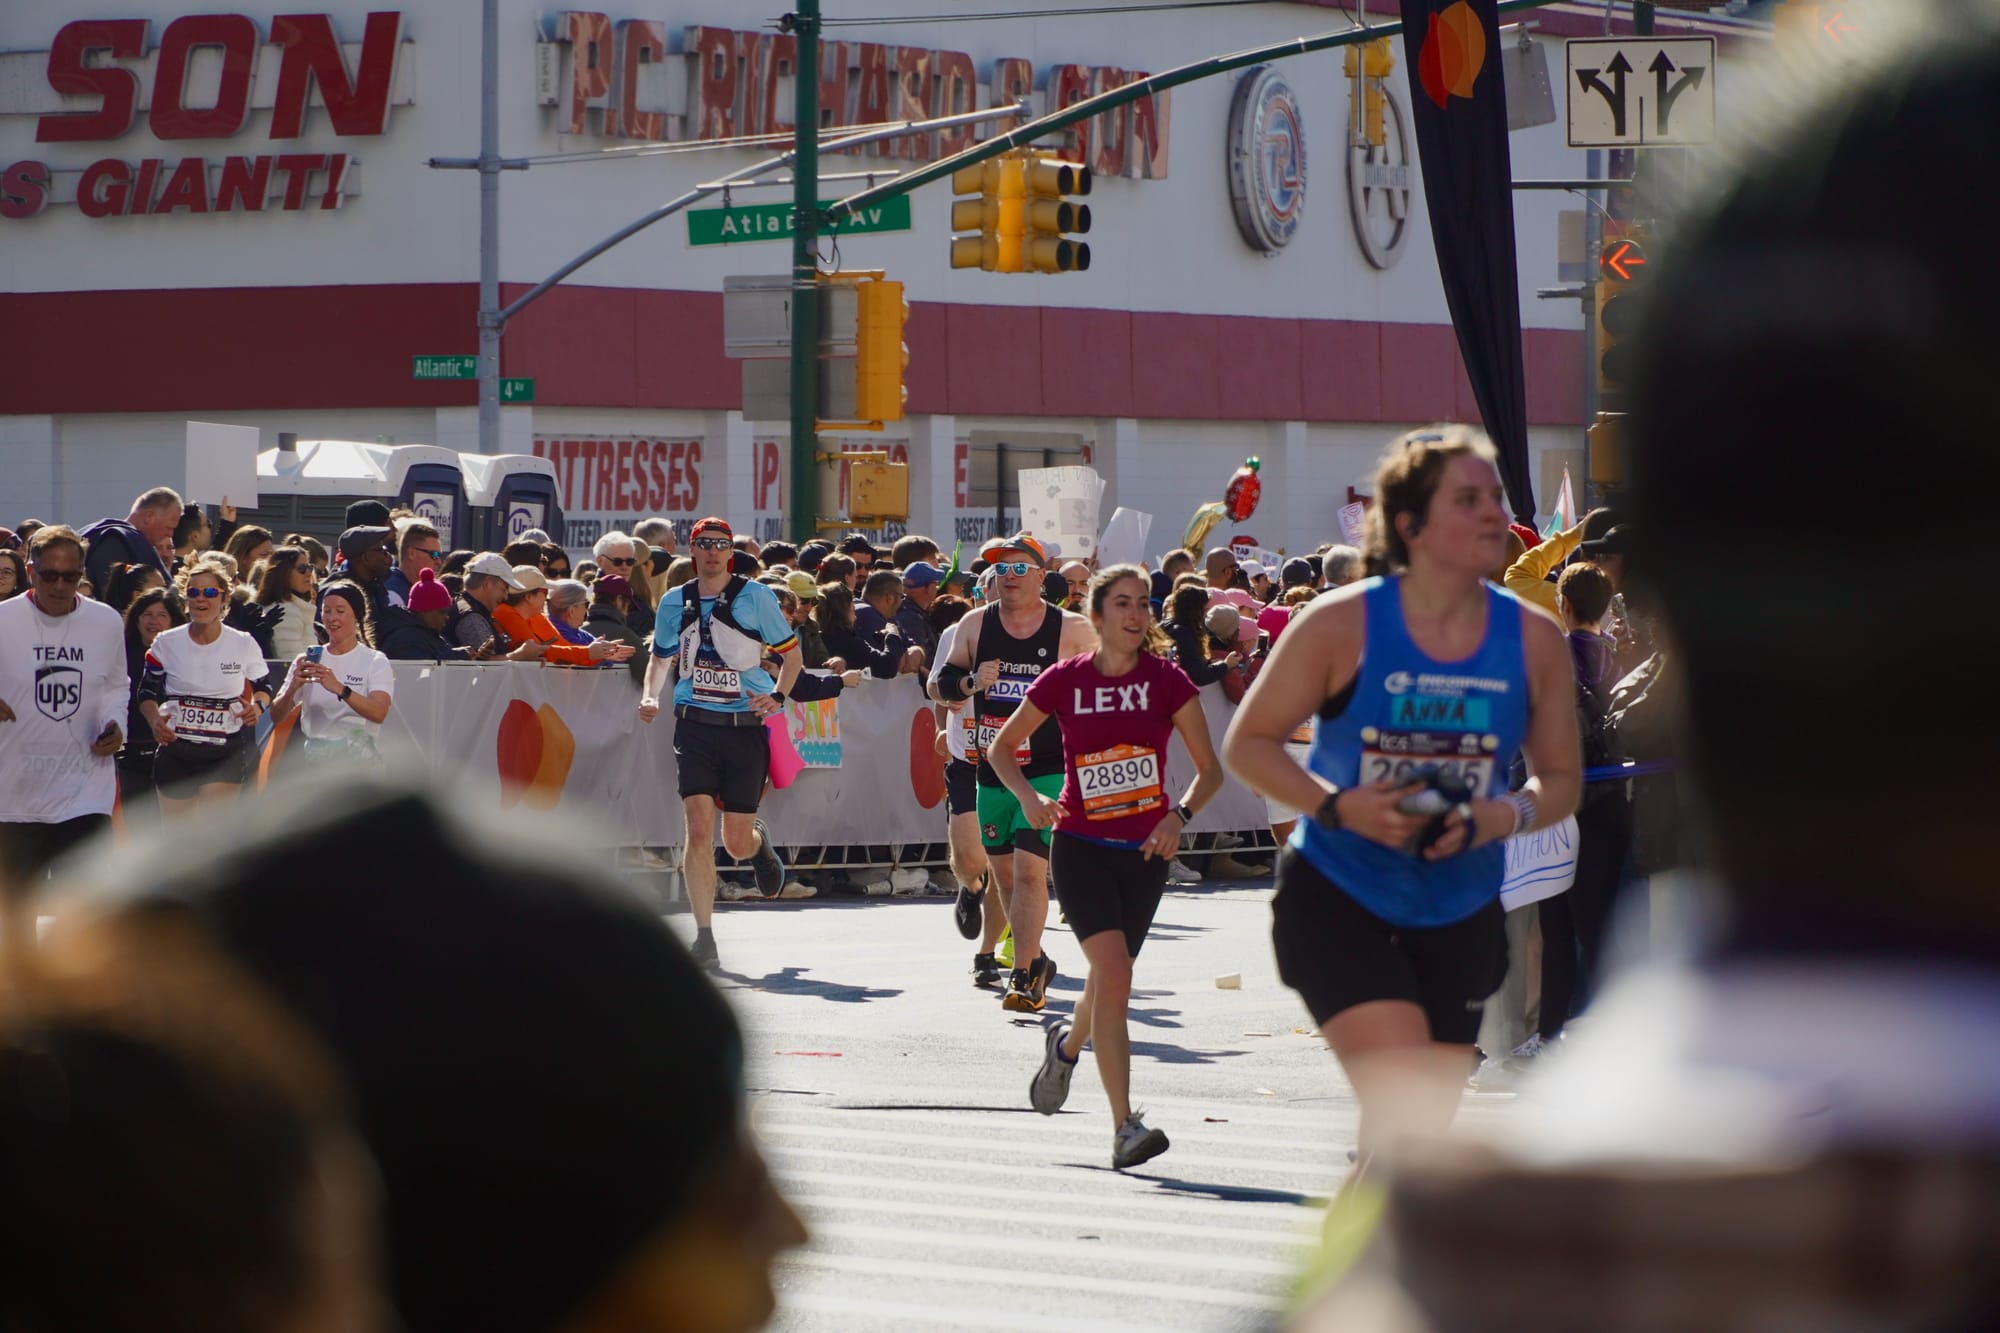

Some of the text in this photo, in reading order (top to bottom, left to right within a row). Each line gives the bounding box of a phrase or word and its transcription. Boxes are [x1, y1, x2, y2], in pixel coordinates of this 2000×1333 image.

[36, 12, 404, 143] SON
[684, 25, 977, 163] RICHARD
[1047, 64, 1169, 180] SON
[76, 153, 353, 218] GIANT!
[850, 208, 882, 226] Av
[415, 358, 462, 377] Atlantic
[504, 381, 513, 399] 4
[33, 647, 84, 661] TEAM
[695, 669, 738, 687] 30048
[39, 683, 79, 713] ups
[1074, 681, 1150, 715] LEXY
[181, 708, 224, 726] 19544
[1082, 758, 1153, 791] 28890
